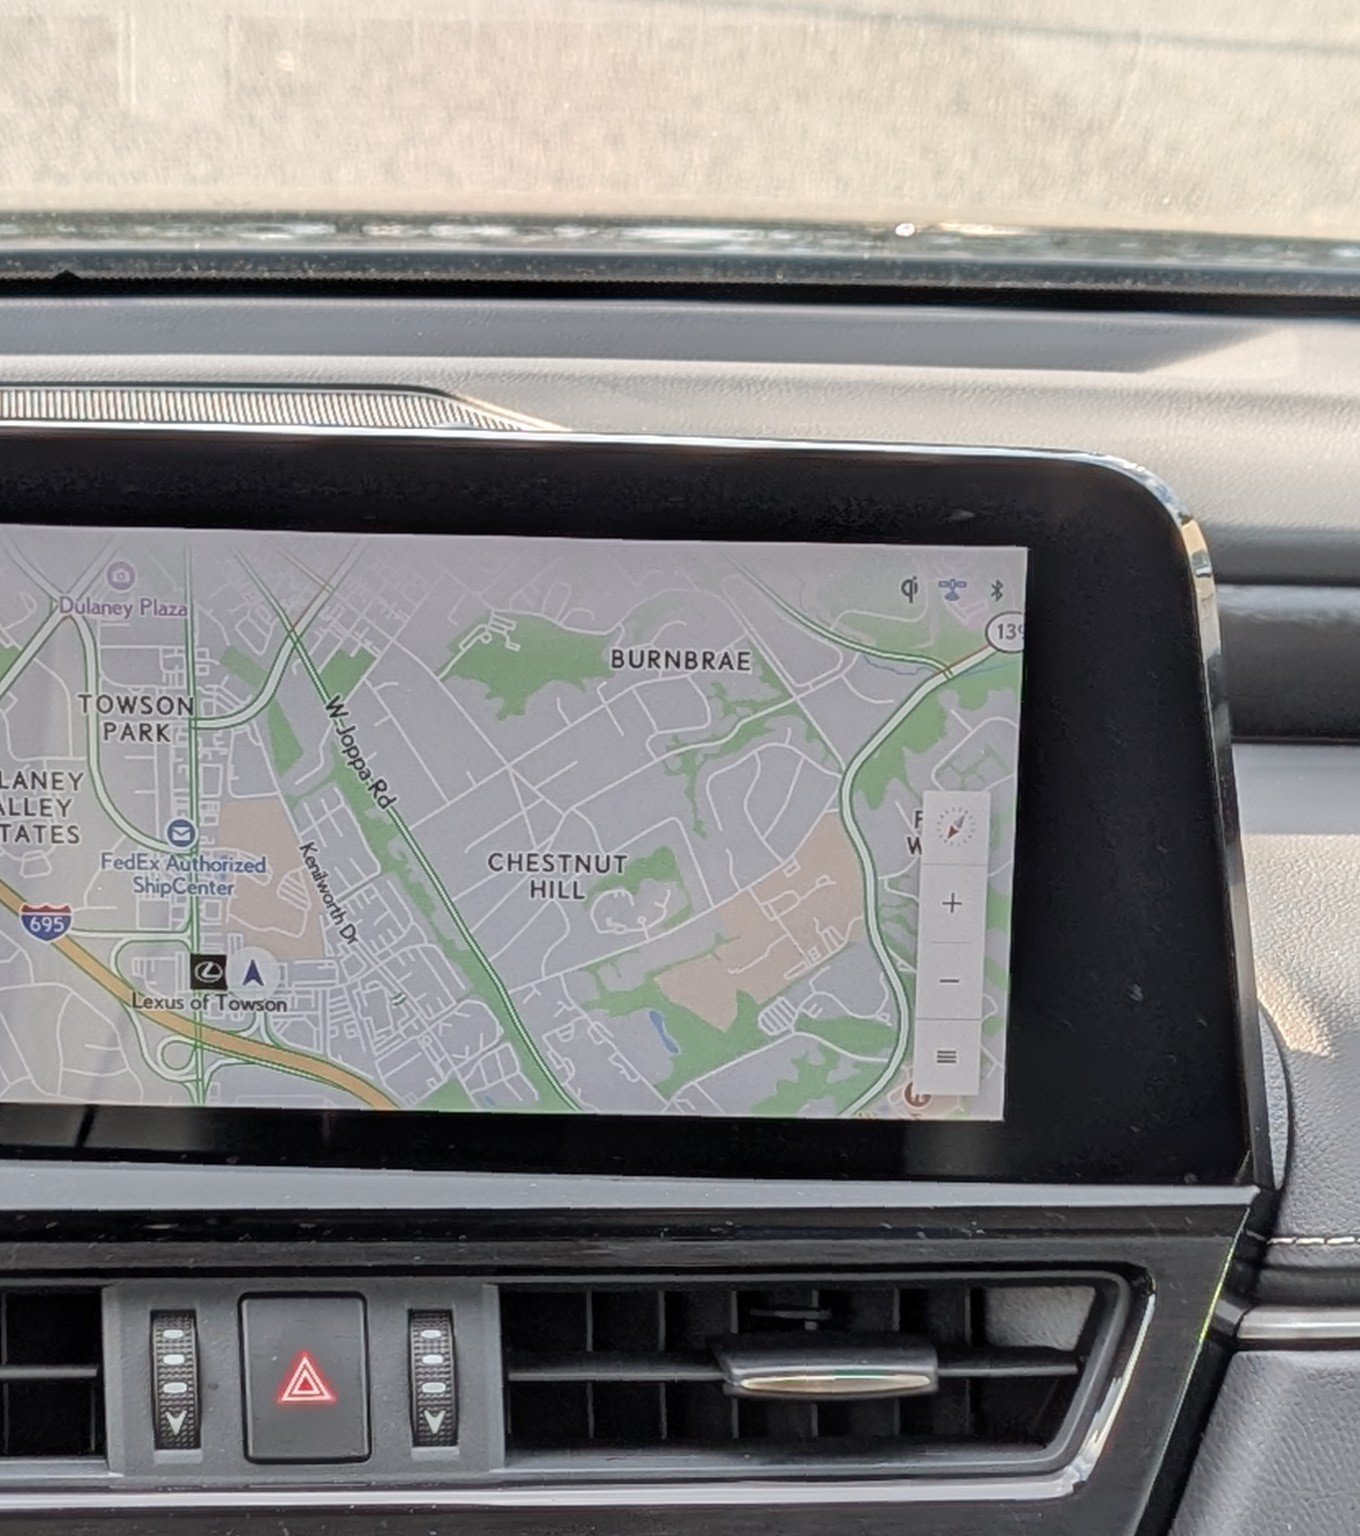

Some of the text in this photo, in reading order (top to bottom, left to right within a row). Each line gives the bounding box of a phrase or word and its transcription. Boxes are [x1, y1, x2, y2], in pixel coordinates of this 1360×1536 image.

[59, 598, 188, 618] Dulaney Plaza
[610, 649, 751, 671] BURNBRAE
[80, 695, 194, 716] TOWSON
[103, 722, 172, 742] PARK
[336, 725, 371, 780] Joppa
[368, 779, 397, 809] Rd
[101, 855, 267, 874] FedEx Authorized
[488, 852, 628, 874] CHESTNUT
[134, 876, 235, 899] ShipCenter
[299, 842, 347, 926] Kenilworth
[530, 880, 586, 900] HILL
[30, 916, 65, 934] 695
[132, 994, 287, 1013] Lexus of Towson
